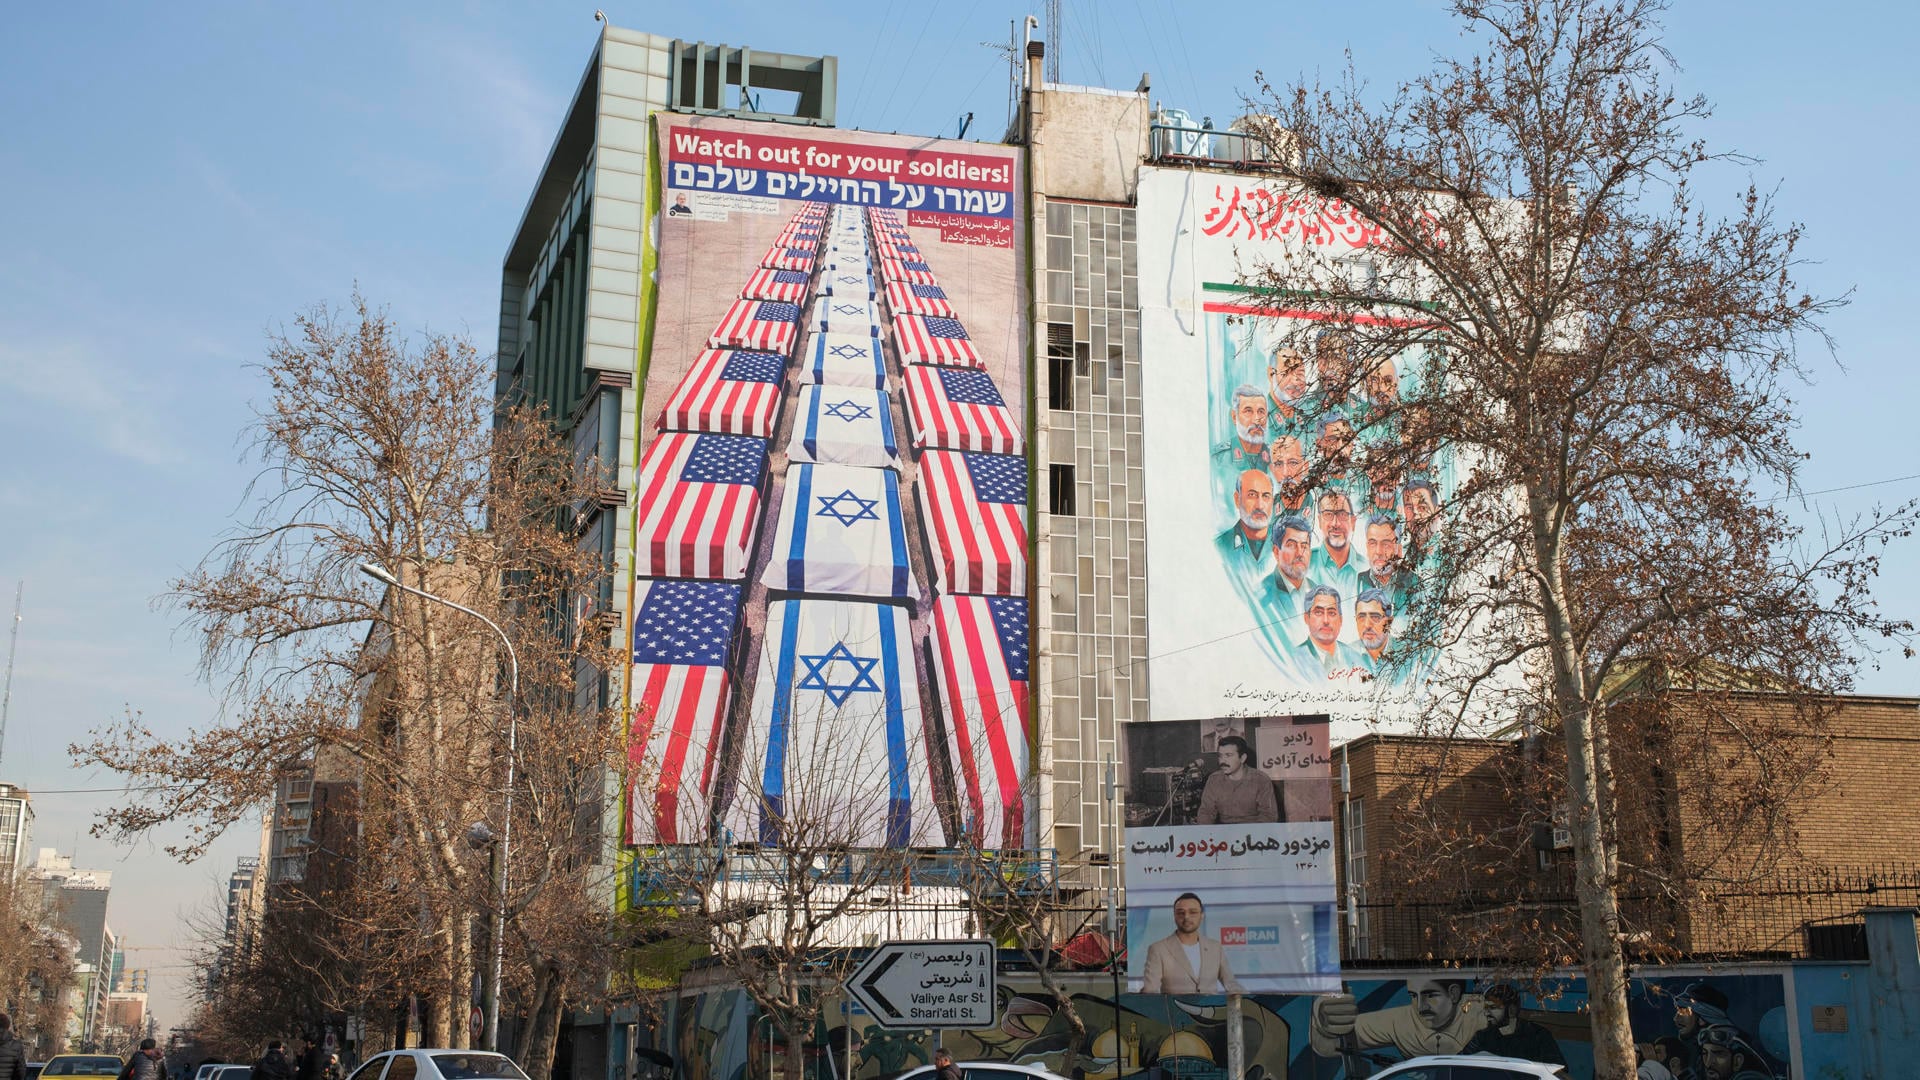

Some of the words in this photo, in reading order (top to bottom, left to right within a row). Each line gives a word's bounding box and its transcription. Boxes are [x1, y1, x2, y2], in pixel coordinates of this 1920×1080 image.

[674, 133, 751, 160] Watch
[758, 147, 800, 164] out
[805, 146, 842, 168] for
[847, 155, 903, 175] your
[909, 158, 1009, 184] soldiers!
[674, 160, 757, 191] שלכם
[766, 168, 881, 204] החיילים
[889, 176, 925, 208] על
[933, 187, 1006, 213] שמרו
[983, 220, 1010, 233] مراقب
[1282, 730, 1314, 747] رادیو
[1262, 752, 1298, 769] آزادی
[1131, 835, 1174, 854] است
[1176, 837, 1228, 858] مزدور
[1231, 834, 1280, 857] همان
[1281, 836, 1330, 857] مزدور
[923, 951, 973, 967] ولیعصر
[920, 971, 973, 989] شریعتی
[911, 993, 945, 1005] Valiye
[950, 994, 968, 1004] Asr
[971, 993, 987, 1003] St.
[910, 1008, 957, 1019] Shari'ati
[961, 1008, 976, 1019] St.
